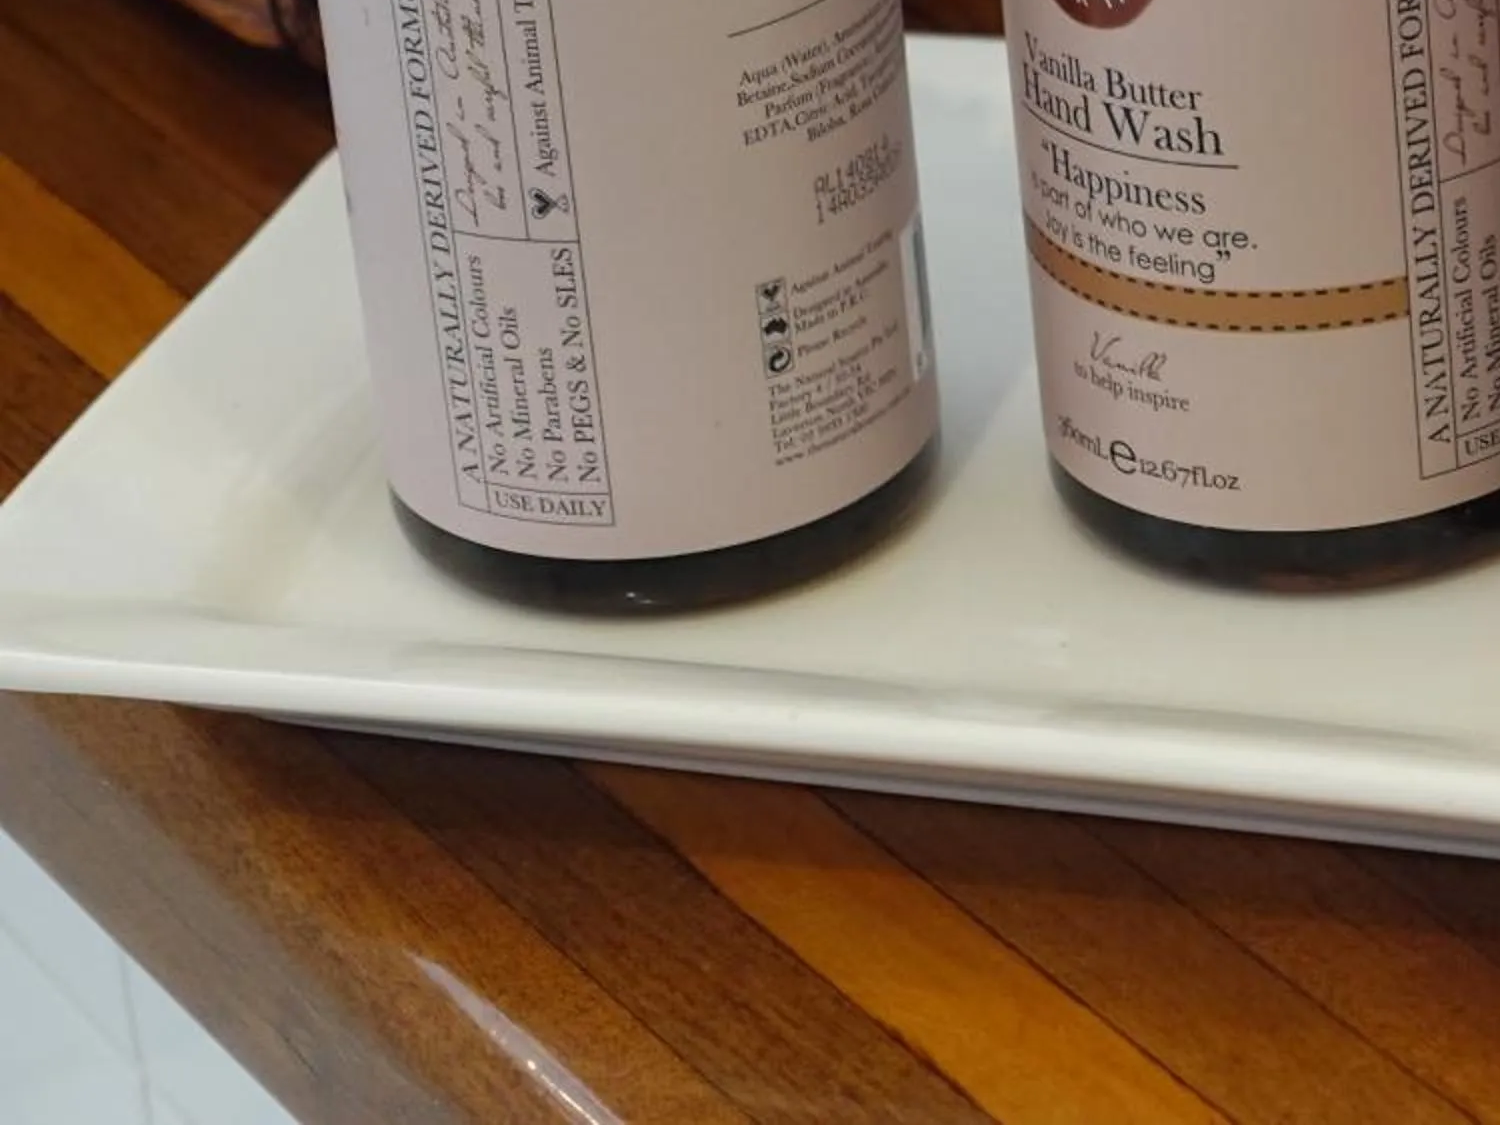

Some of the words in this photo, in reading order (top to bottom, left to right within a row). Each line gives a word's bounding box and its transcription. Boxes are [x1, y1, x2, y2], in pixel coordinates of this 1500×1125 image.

[516, 20, 545, 95] Animal
[739, 63, 778, 89] Aqua
[1025, 30, 1098, 94] Vanilla
[1104, 67, 1204, 112] Butter
[455, 96, 465, 121] in
[1022, 62, 1094, 134] Hand
[1102, 102, 1225, 156] Wash
[474, 123, 501, 172] and
[526, 102, 559, 176] Against
[1403, 71, 1436, 214] DERIVED
[413, 109, 450, 256] DERIVED
[447, 122, 487, 227] Designed
[1071, 230, 1084, 249] is
[1088, 233, 1123, 263] the
[1075, 200, 1093, 223] of
[1099, 209, 1148, 238] who
[1152, 224, 1194, 247] we
[1202, 229, 1258, 251] are.
[1452, 196, 1471, 283] Colours
[552, 247, 578, 308] SLES
[1478, 233, 1499, 281] Oils
[465, 254, 489, 338] Colours
[497, 307, 521, 351] Oils
[561, 316, 584, 348] No
[1412, 225, 1449, 420] NATURALLY
[1455, 289, 1478, 379] Artificial
[433, 264, 477, 453] NATURALLY
[565, 354, 587, 374] &
[475, 347, 500, 431] Artificial
[504, 358, 533, 441] Mineral
[536, 346, 563, 442] Parabens
[567, 379, 595, 444] PEGS
[1073, 359, 1089, 381] to
[1089, 365, 1125, 401] help
[1127, 380, 1191, 412] inspire
[1462, 386, 1481, 423] No
[487, 443, 509, 476] No
[1428, 424, 1452, 444] A
[1463, 429, 1500, 456] USE
[462, 462, 481, 484] A
[517, 446, 538, 479] No
[548, 449, 569, 482] No
[578, 451, 601, 483] No
[494, 490, 535, 512] USE
[538, 493, 607, 518] DAILY
